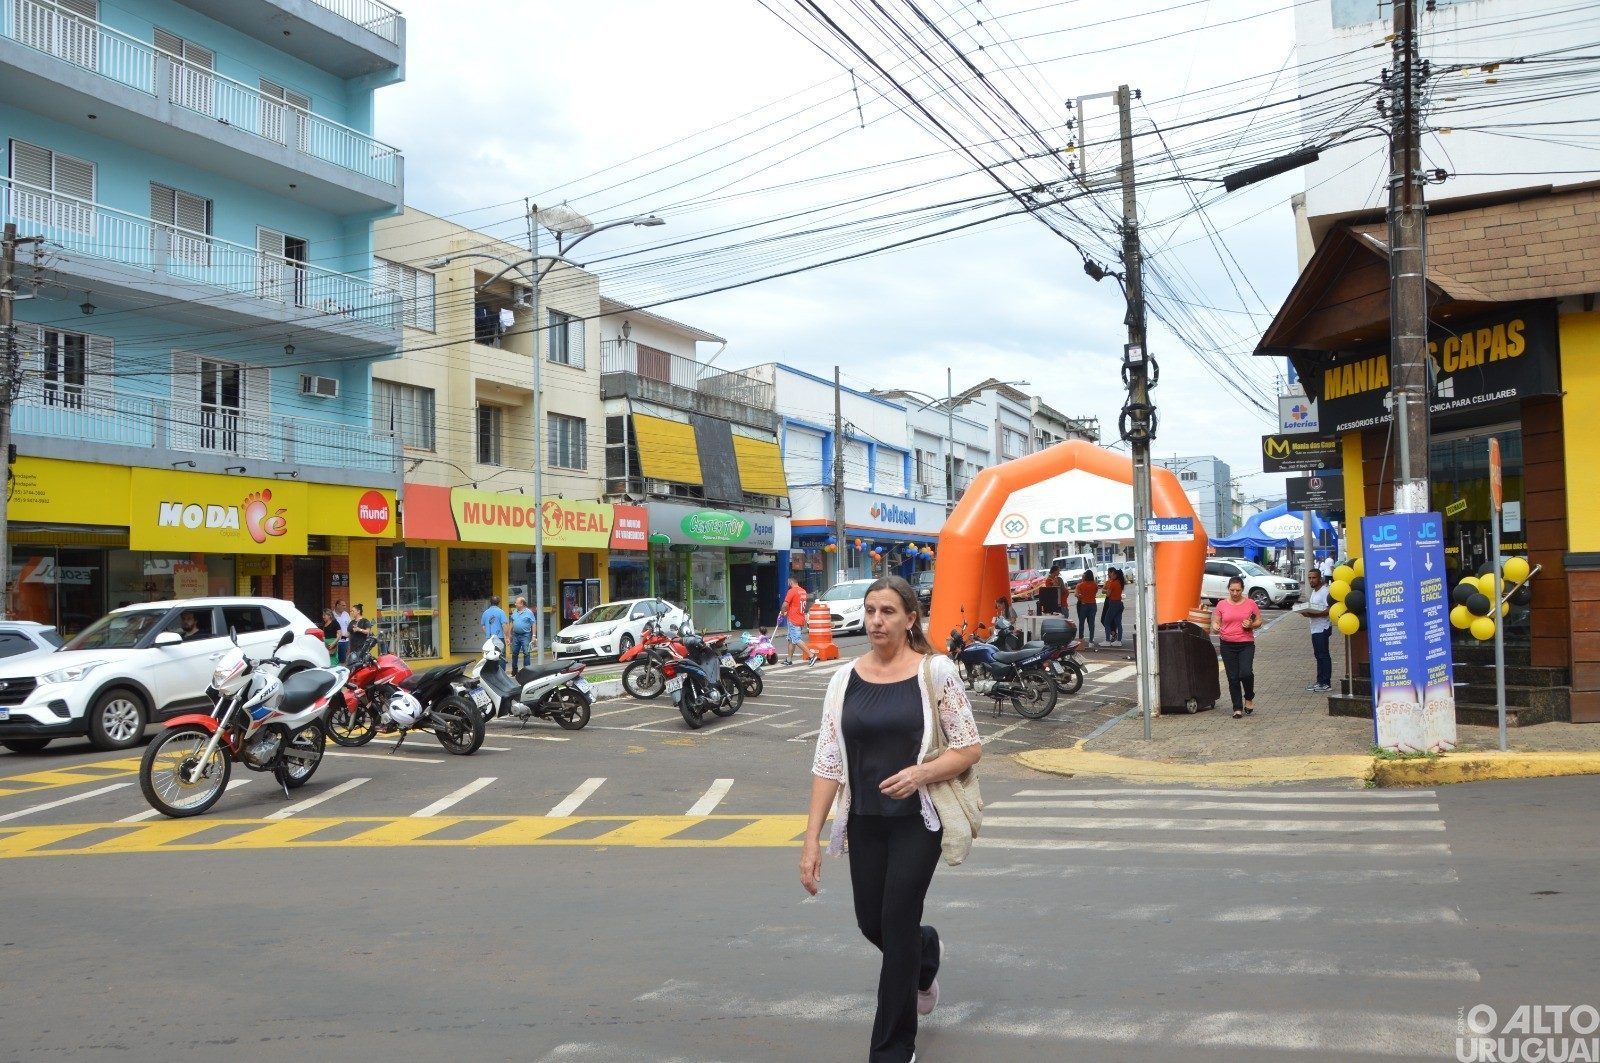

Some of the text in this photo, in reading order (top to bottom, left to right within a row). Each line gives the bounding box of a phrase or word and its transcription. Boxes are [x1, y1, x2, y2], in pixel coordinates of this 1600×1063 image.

[1324, 354, 1389, 400] MANIA
[1443, 319, 1525, 373] CAPAS
[1336, 417, 1373, 431] ACESSÓRIOS
[1429, 402, 1451, 413] CNICA
[1452, 398, 1471, 409] PARA
[1472, 388, 1517, 404] CELULARES
[1284, 420, 1317, 428] Loterias
[158, 501, 240, 529] MODA
[361, 506, 388, 520] mundi
[463, 502, 609, 533] MUNDO REAL
[880, 502, 916, 526] Deltasul
[627, 520, 641, 528] MUNDO
[1040, 513, 1134, 535] CRESO
[1148, 523, 1160, 532] JOSÉ
[1418, 522, 1437, 539] JC
[622, 530, 645, 540] VARIEDADES
[1372, 524, 1398, 542] JC
[1376, 586, 1404, 598] RÁPIDO
[1420, 583, 1442, 595] RÁPIDO
[1382, 667, 1408, 675] TRADIÇÃO
